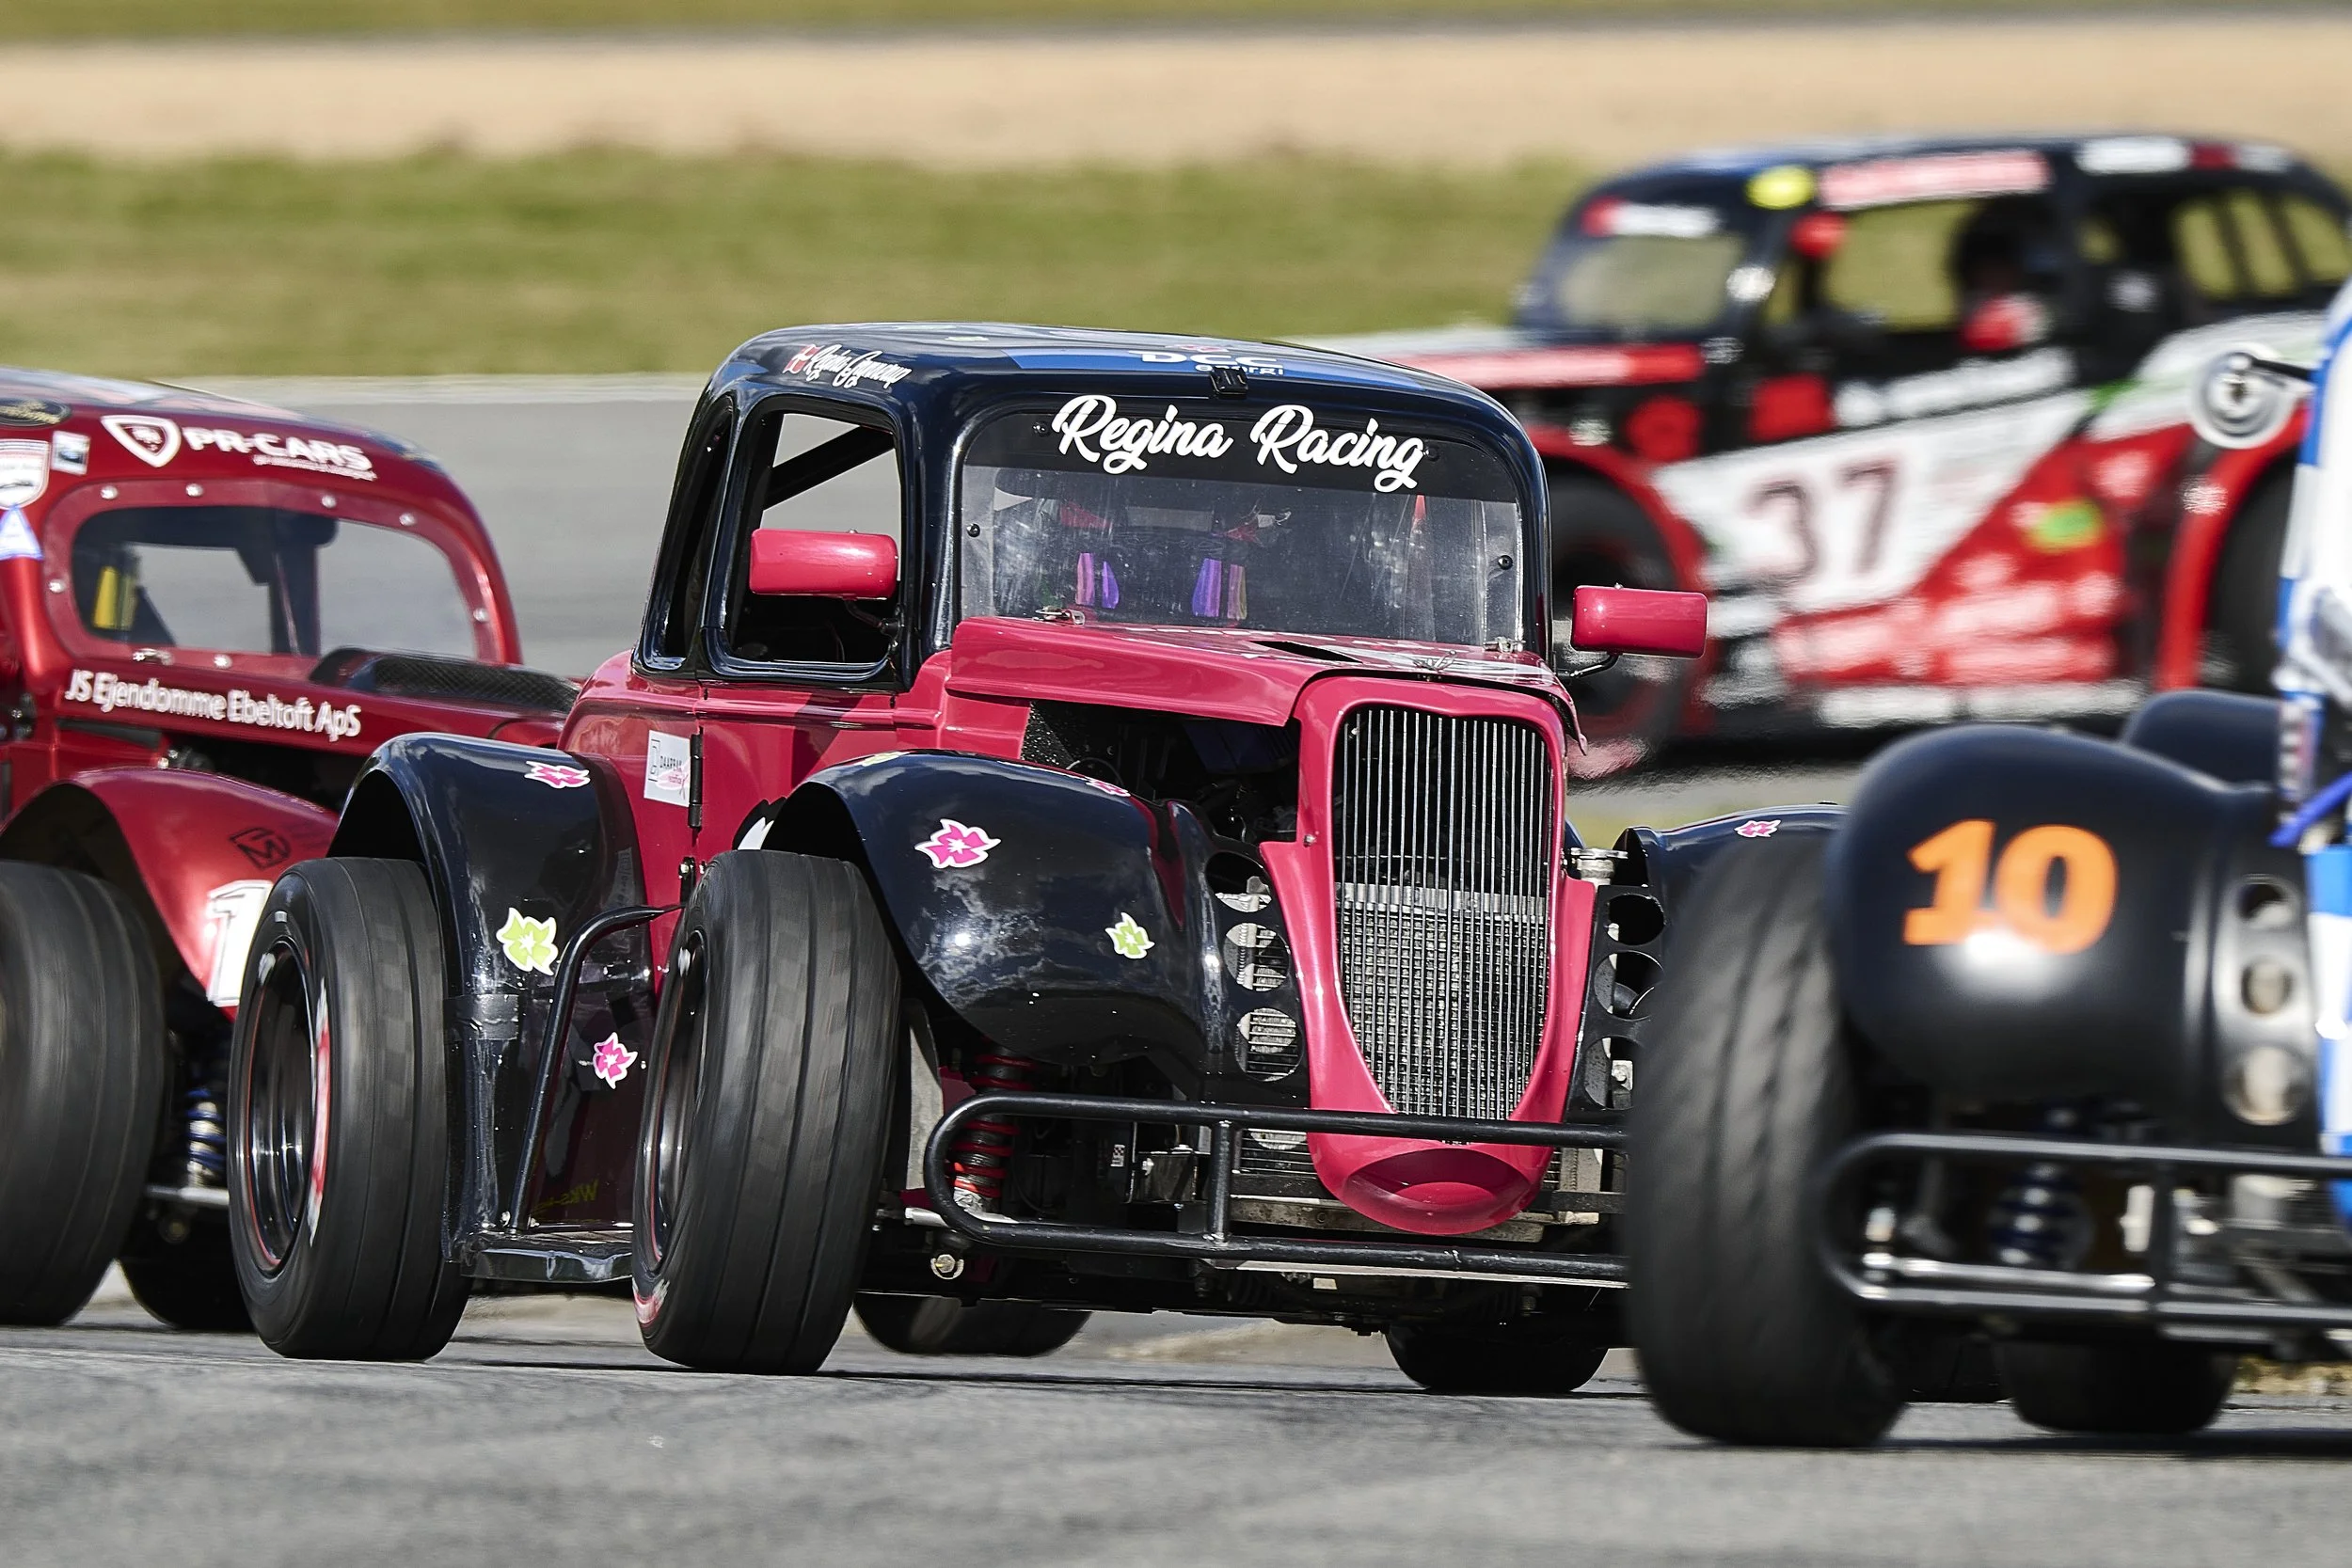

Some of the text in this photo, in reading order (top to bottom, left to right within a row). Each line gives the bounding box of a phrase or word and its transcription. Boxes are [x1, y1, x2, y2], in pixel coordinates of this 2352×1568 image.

[1129, 350, 1283, 369] DCC
[1195, 364, 1284, 375] ergi
[183, 427, 373, 471] PR-CARS
[1051, 394, 1425, 493] Regina Racing
[1740, 457, 1902, 583] 37
[64, 669, 362, 742] JS Ejendomme Ebeltoft ApS
[1902, 818, 2119, 955] 10
